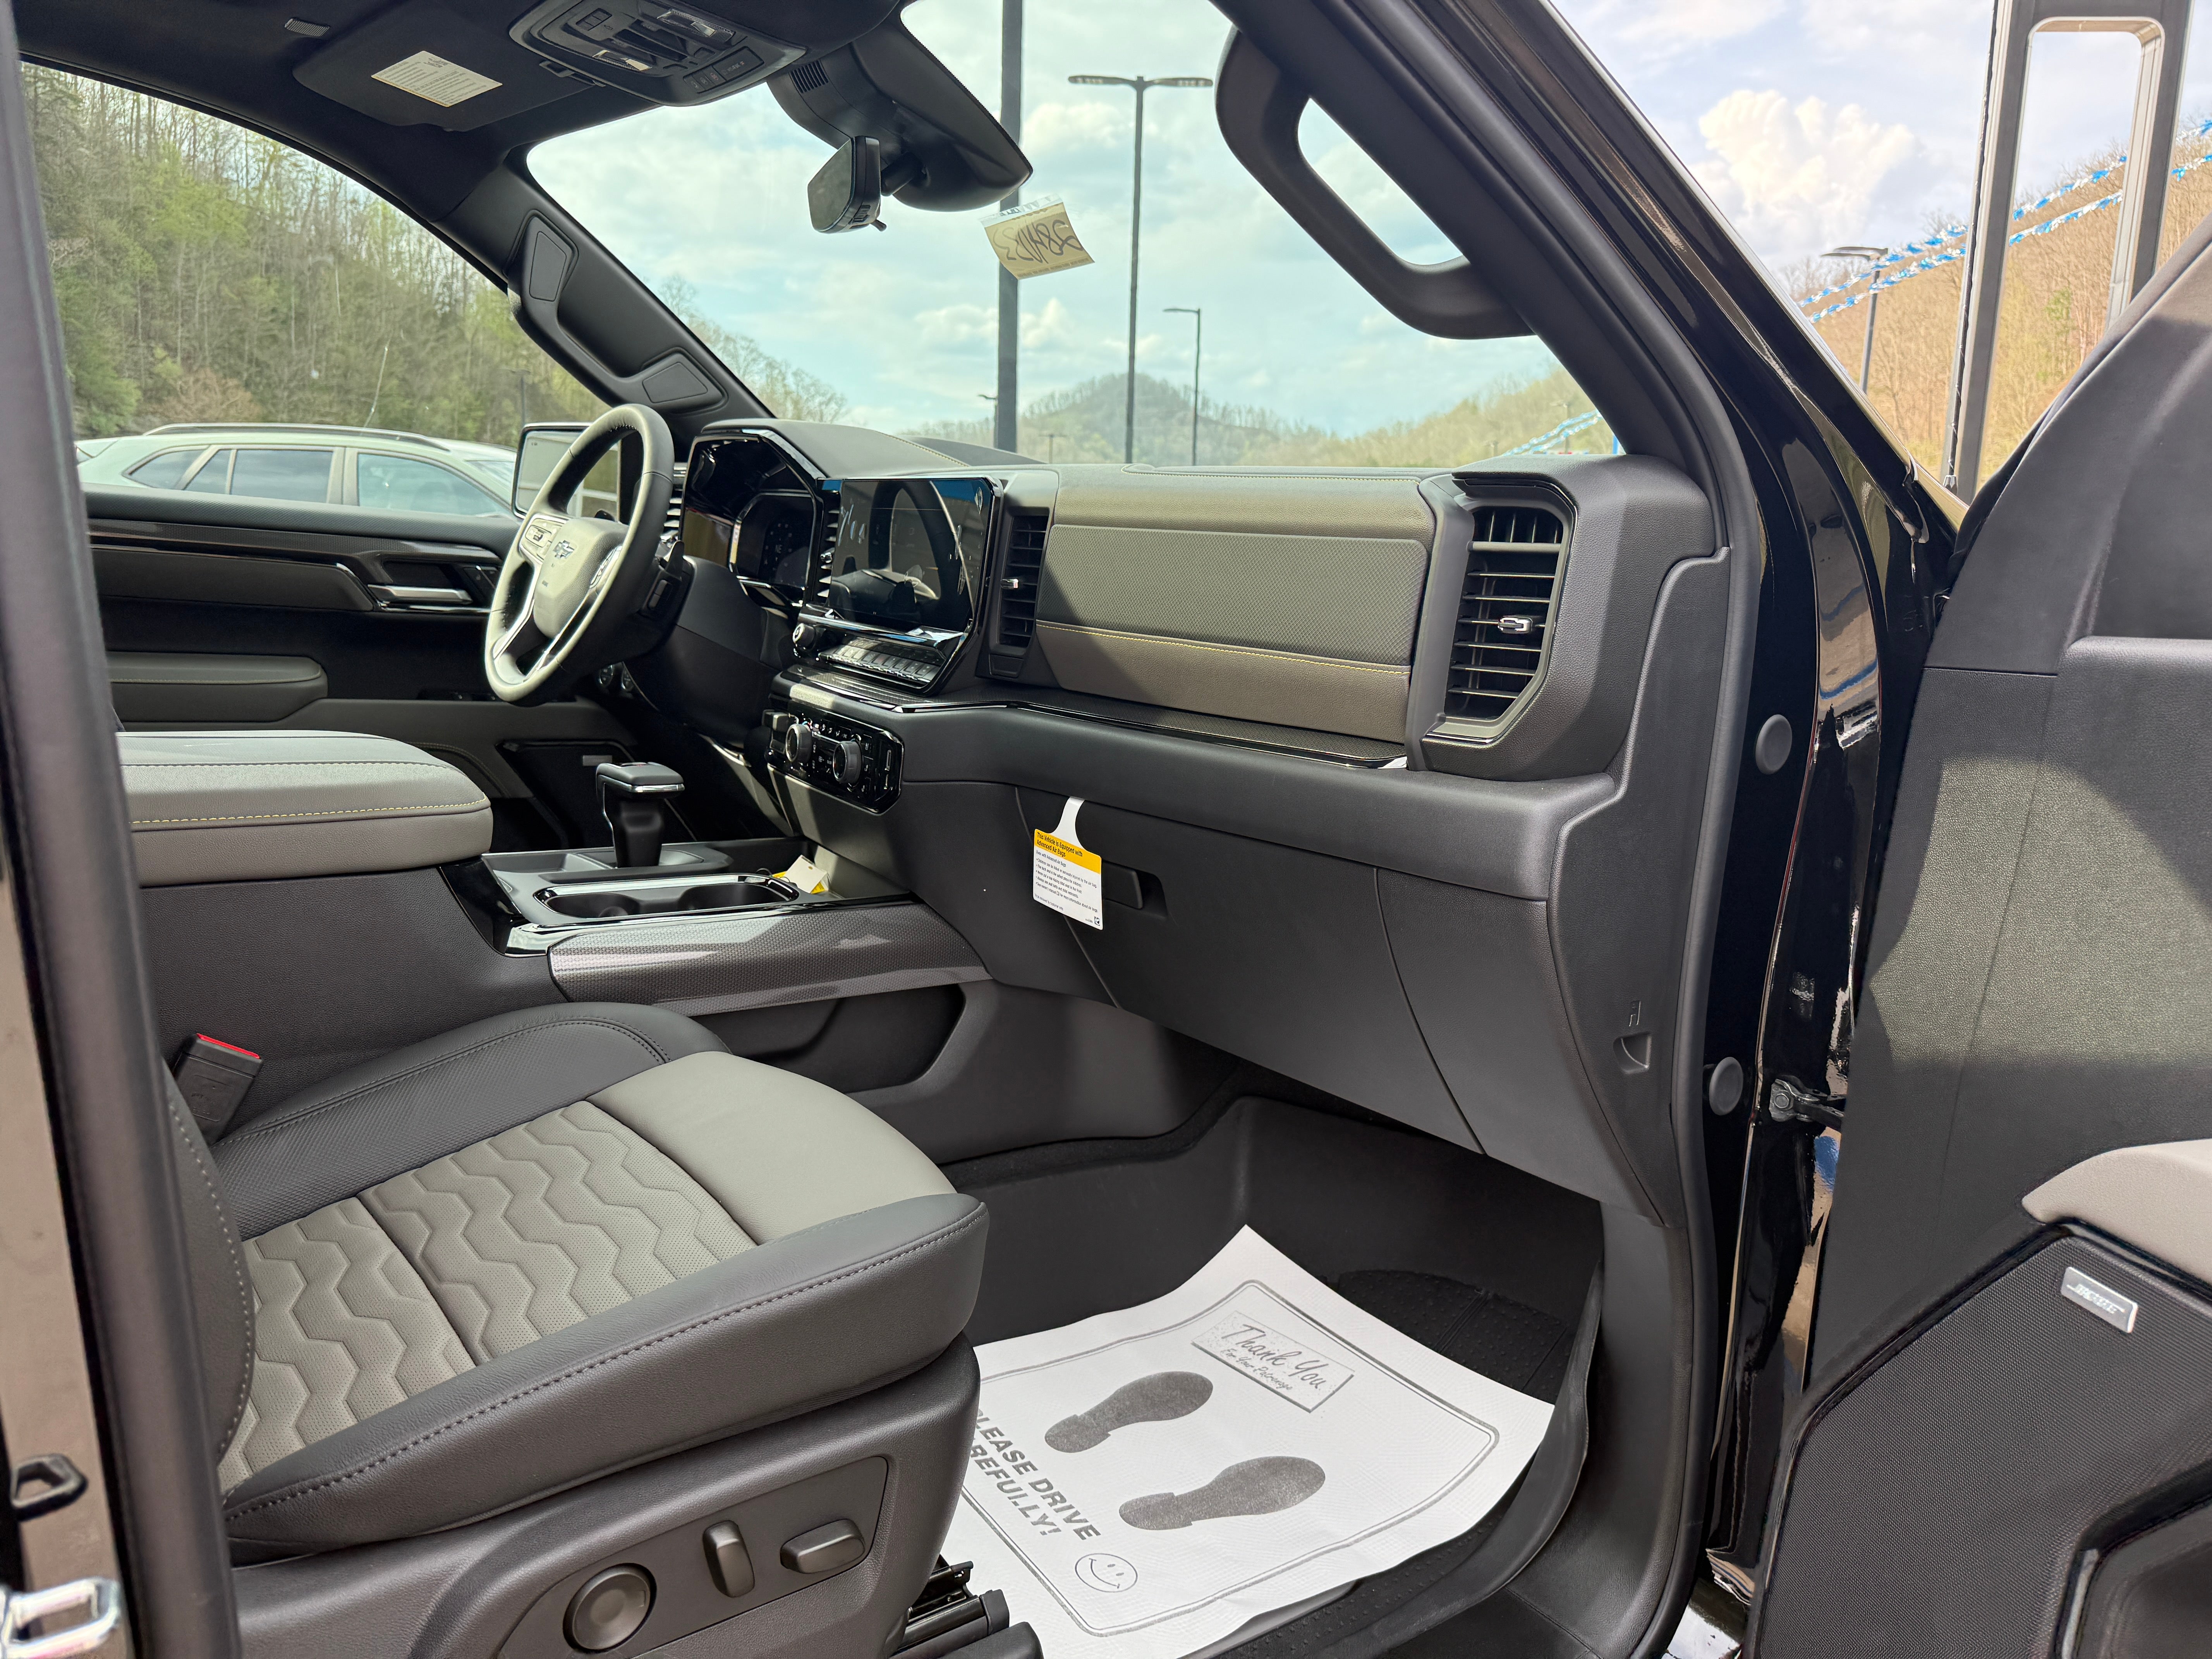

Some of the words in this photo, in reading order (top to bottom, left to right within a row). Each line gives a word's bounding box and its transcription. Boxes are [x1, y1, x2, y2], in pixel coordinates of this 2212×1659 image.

[1044, 835, 1055, 845] Vehicle
[1059, 842, 1074, 854] Equipped
[1057, 848, 1065, 857] Bags
[1221, 1324, 1302, 1366] Thank
[1288, 1360, 1329, 1389] You
[970, 1444, 1061, 1536] REFULLY!
[1028, 1478, 1101, 1540] DRIVE
